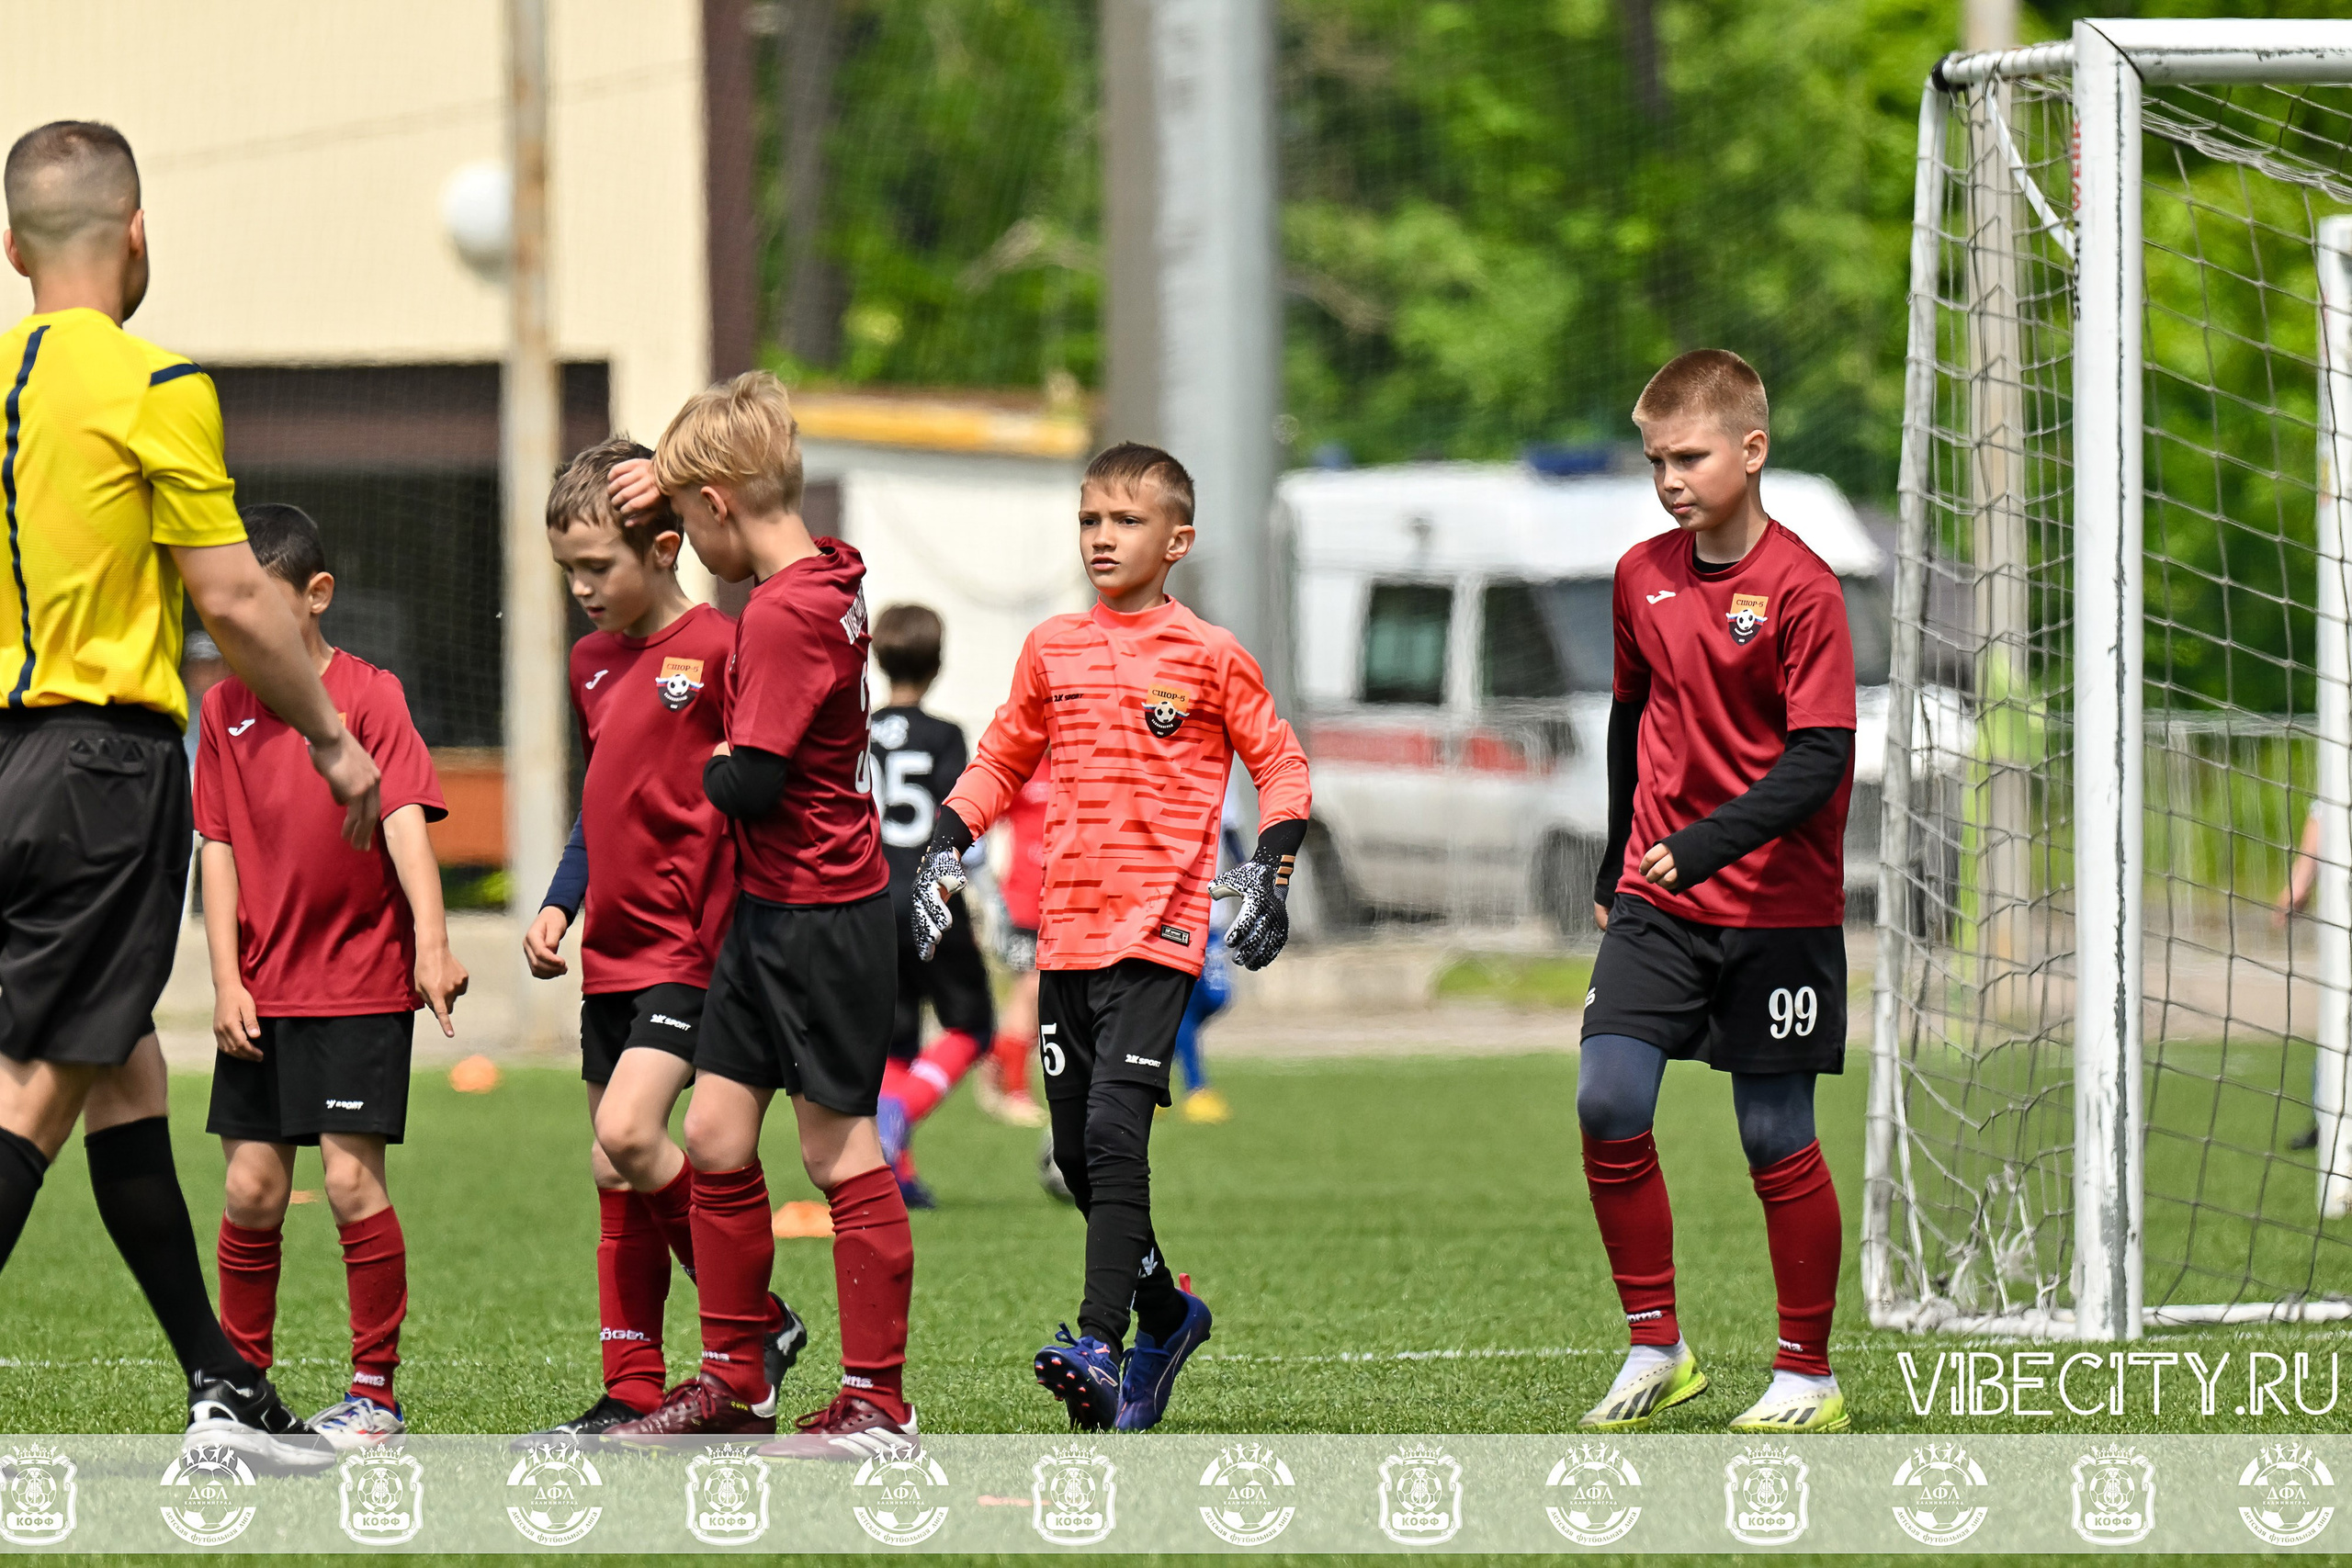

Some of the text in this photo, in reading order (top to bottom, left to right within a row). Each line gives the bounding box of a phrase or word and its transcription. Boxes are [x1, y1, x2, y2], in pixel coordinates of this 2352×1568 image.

[1152, 689, 1186, 703] СШОР-5
[1768, 986, 1818, 1040] 99
[1138, 1058, 1161, 1067] SPORT
